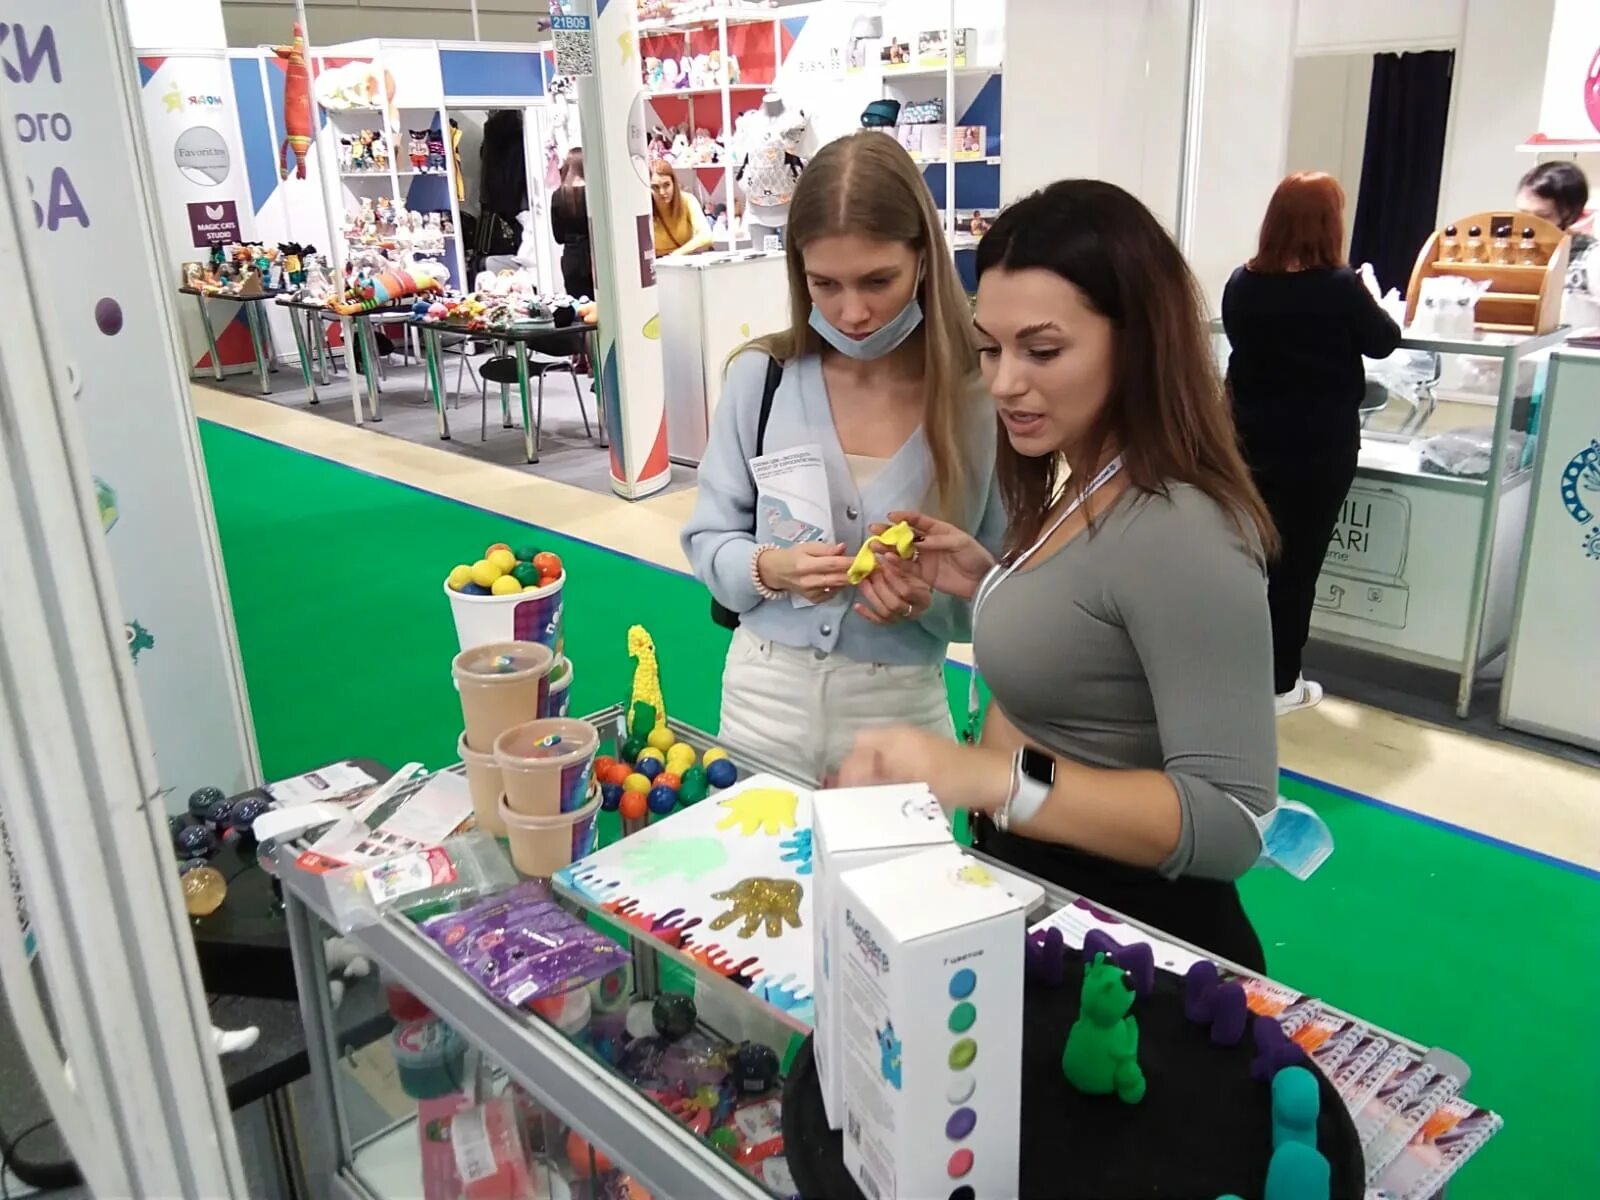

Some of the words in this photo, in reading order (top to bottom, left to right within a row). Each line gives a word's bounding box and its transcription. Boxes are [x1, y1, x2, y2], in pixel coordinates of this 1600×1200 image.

[553, 17, 586, 29] 21B09
[27, 166, 90, 231] А
[197, 223, 220, 231] MAGIC
[220, 221, 236, 230] CATS
[207, 231, 232, 240] STUDIO
[1336, 499, 1372, 529] ILI
